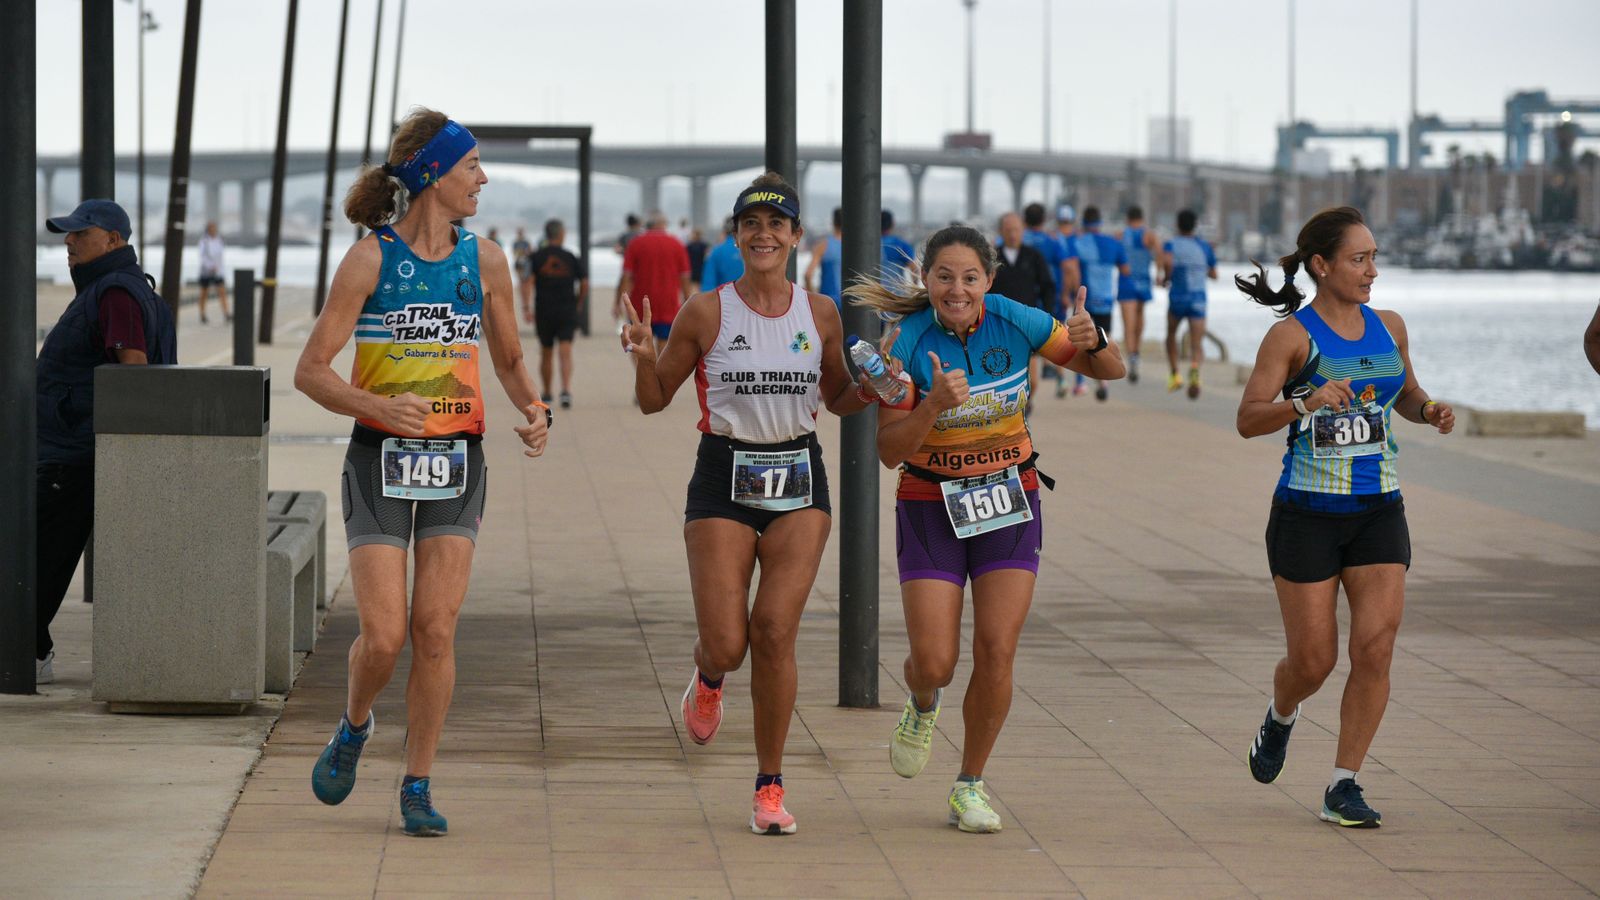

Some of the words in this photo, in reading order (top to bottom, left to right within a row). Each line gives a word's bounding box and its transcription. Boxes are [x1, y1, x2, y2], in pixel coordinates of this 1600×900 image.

[756, 192, 785, 204] WPT
[408, 306, 451, 323] TRAIL
[396, 326, 440, 341] TEAM
[404, 348, 439, 358] Gabarras
[441, 349, 447, 358] &
[721, 371, 755, 382] CLUB
[760, 370, 818, 384] TRIATLÓN
[735, 384, 808, 395] ALGECIRAS
[1334, 415, 1370, 445] 30
[927, 446, 1021, 470] Algeciras
[398, 455, 450, 487] 149
[760, 468, 787, 497] 17
[959, 484, 1012, 522] 150
